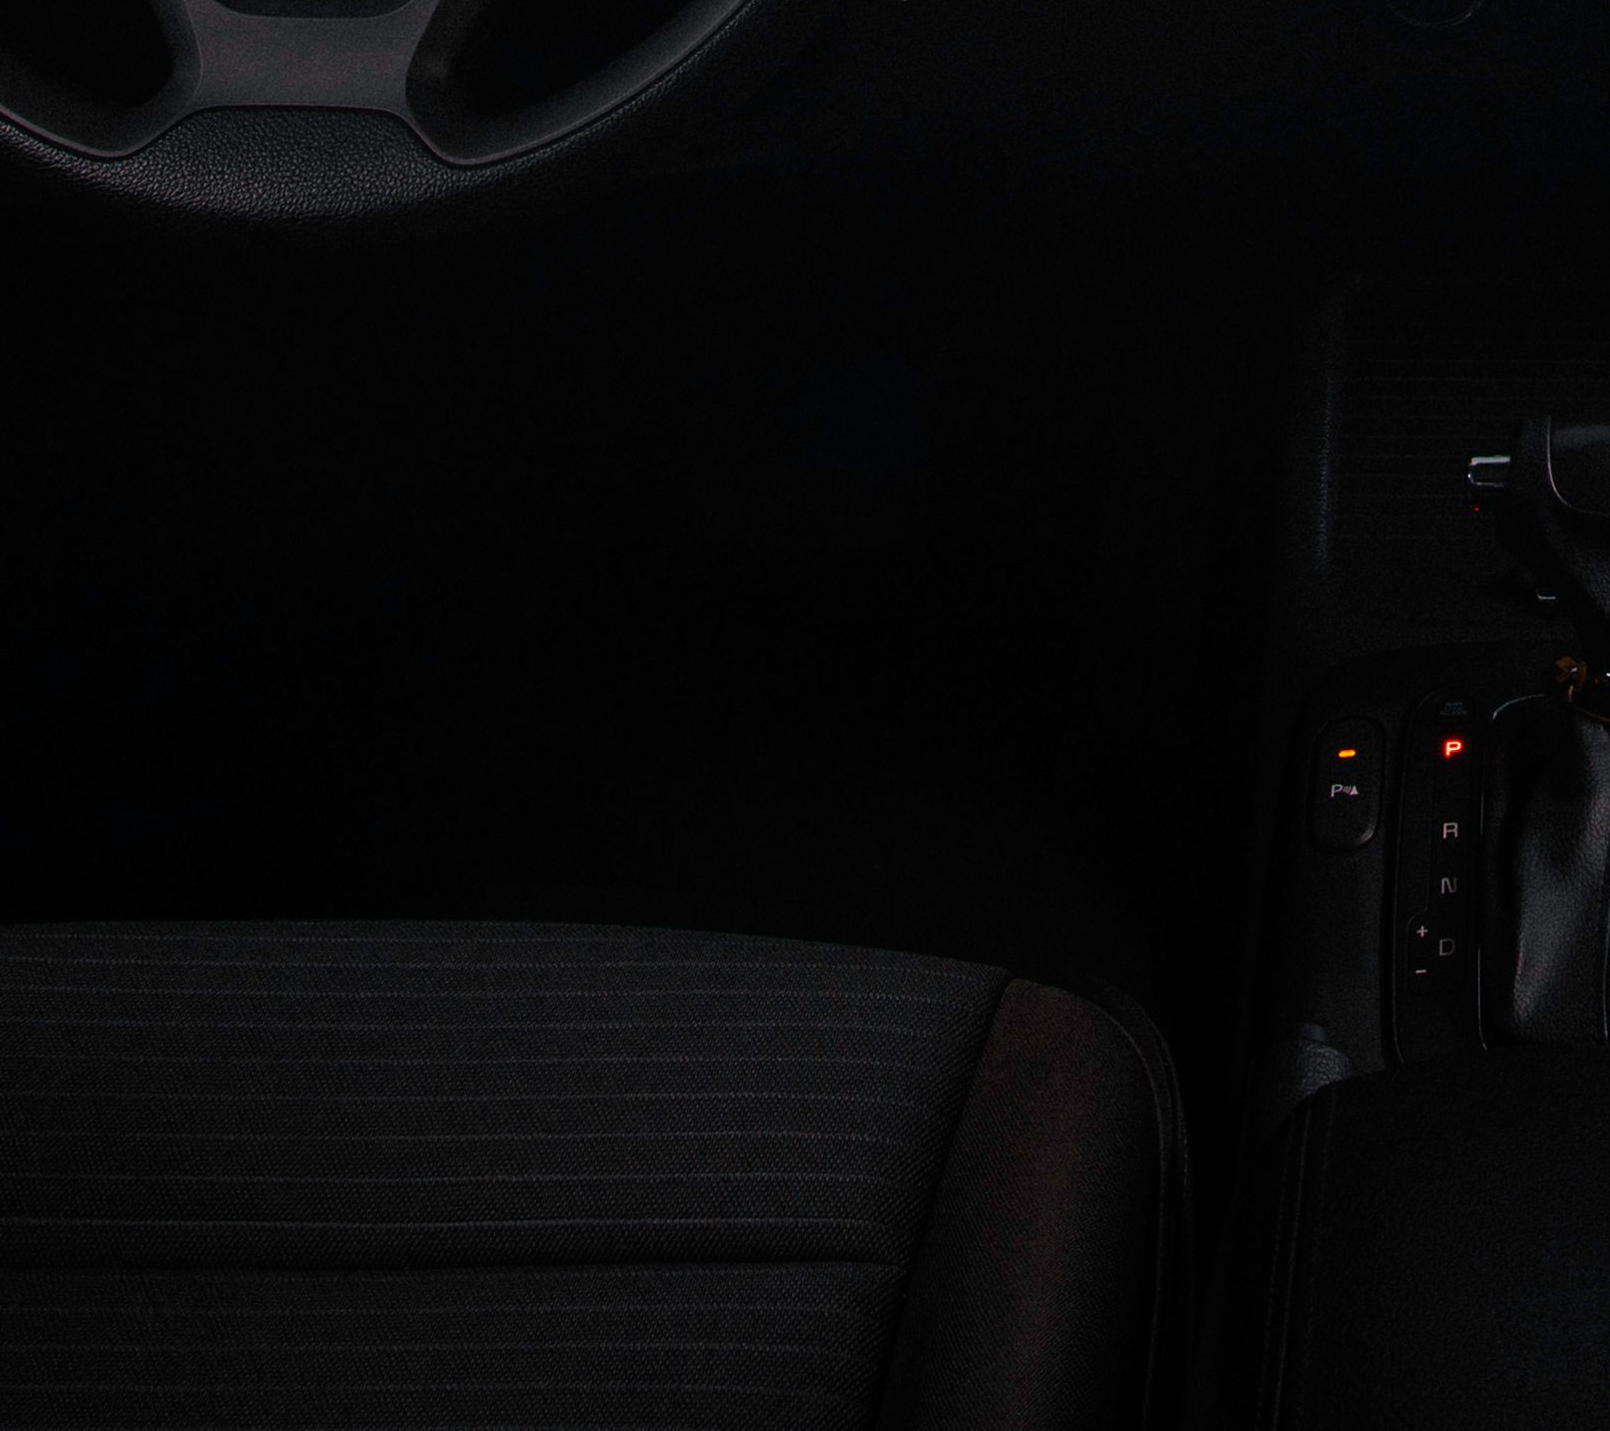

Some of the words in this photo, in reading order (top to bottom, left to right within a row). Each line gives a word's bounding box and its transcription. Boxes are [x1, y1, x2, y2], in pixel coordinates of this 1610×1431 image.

[1444, 739, 1463, 759] P
[1442, 821, 1459, 839] R
[1440, 877, 1457, 895] N
[1438, 938, 1456, 956] D
